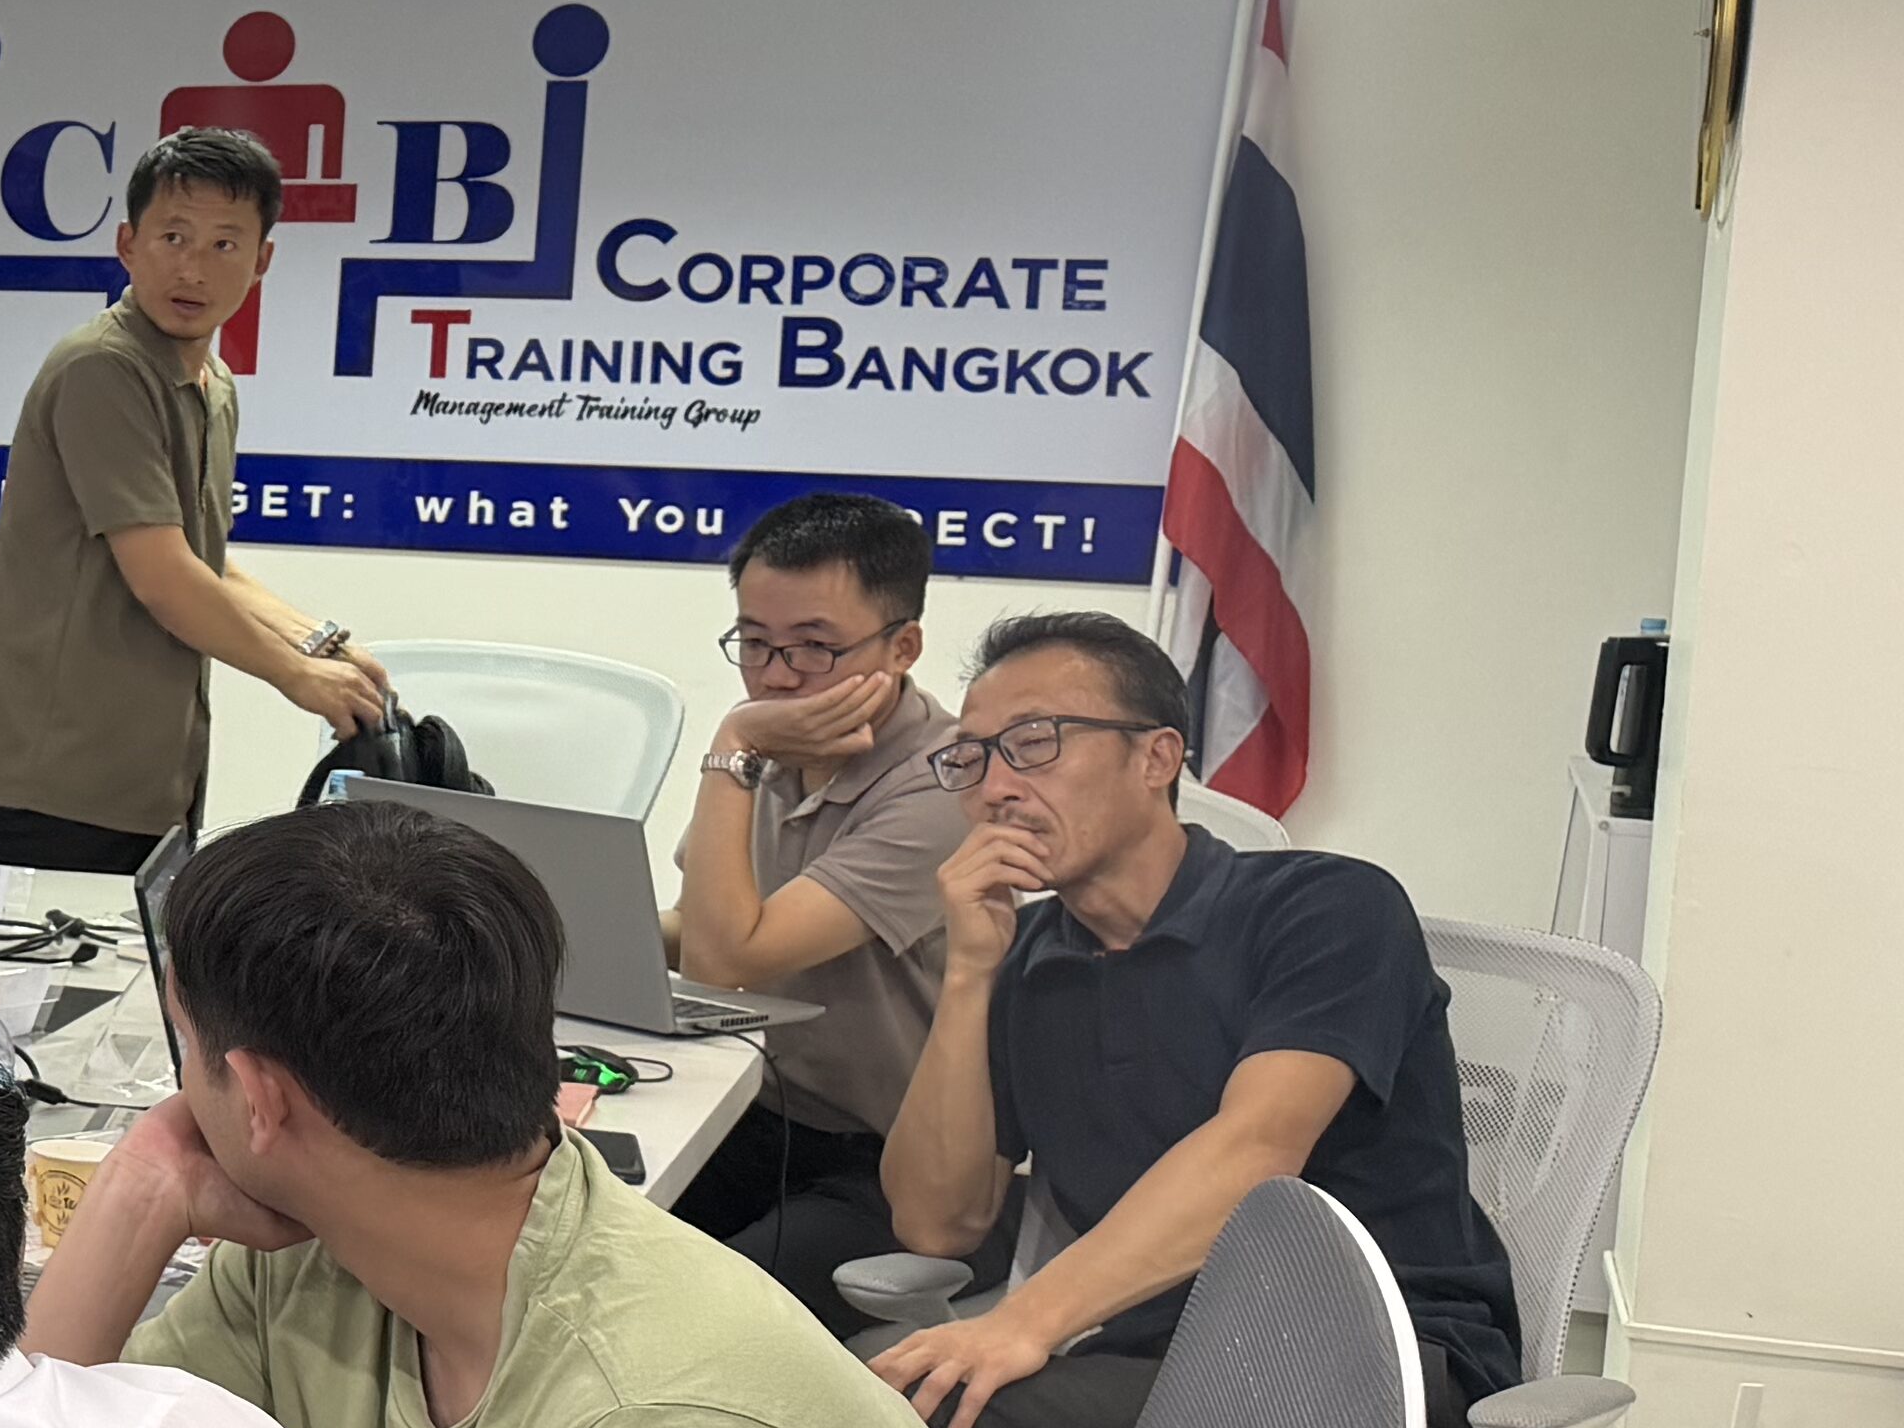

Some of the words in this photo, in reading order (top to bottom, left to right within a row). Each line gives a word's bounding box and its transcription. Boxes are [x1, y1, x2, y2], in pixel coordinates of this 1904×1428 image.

[595, 218, 1108, 311] CORPORATE
[410, 309, 743, 386] TRAINING
[778, 316, 1155, 398] BANGKOK
[410, 389, 572, 425] Management
[575, 393, 678, 428] Training
[683, 400, 762, 432] Group
[415, 490, 570, 530] what
[618, 498, 724, 536] You
[905, 509, 1096, 554] ECT!
